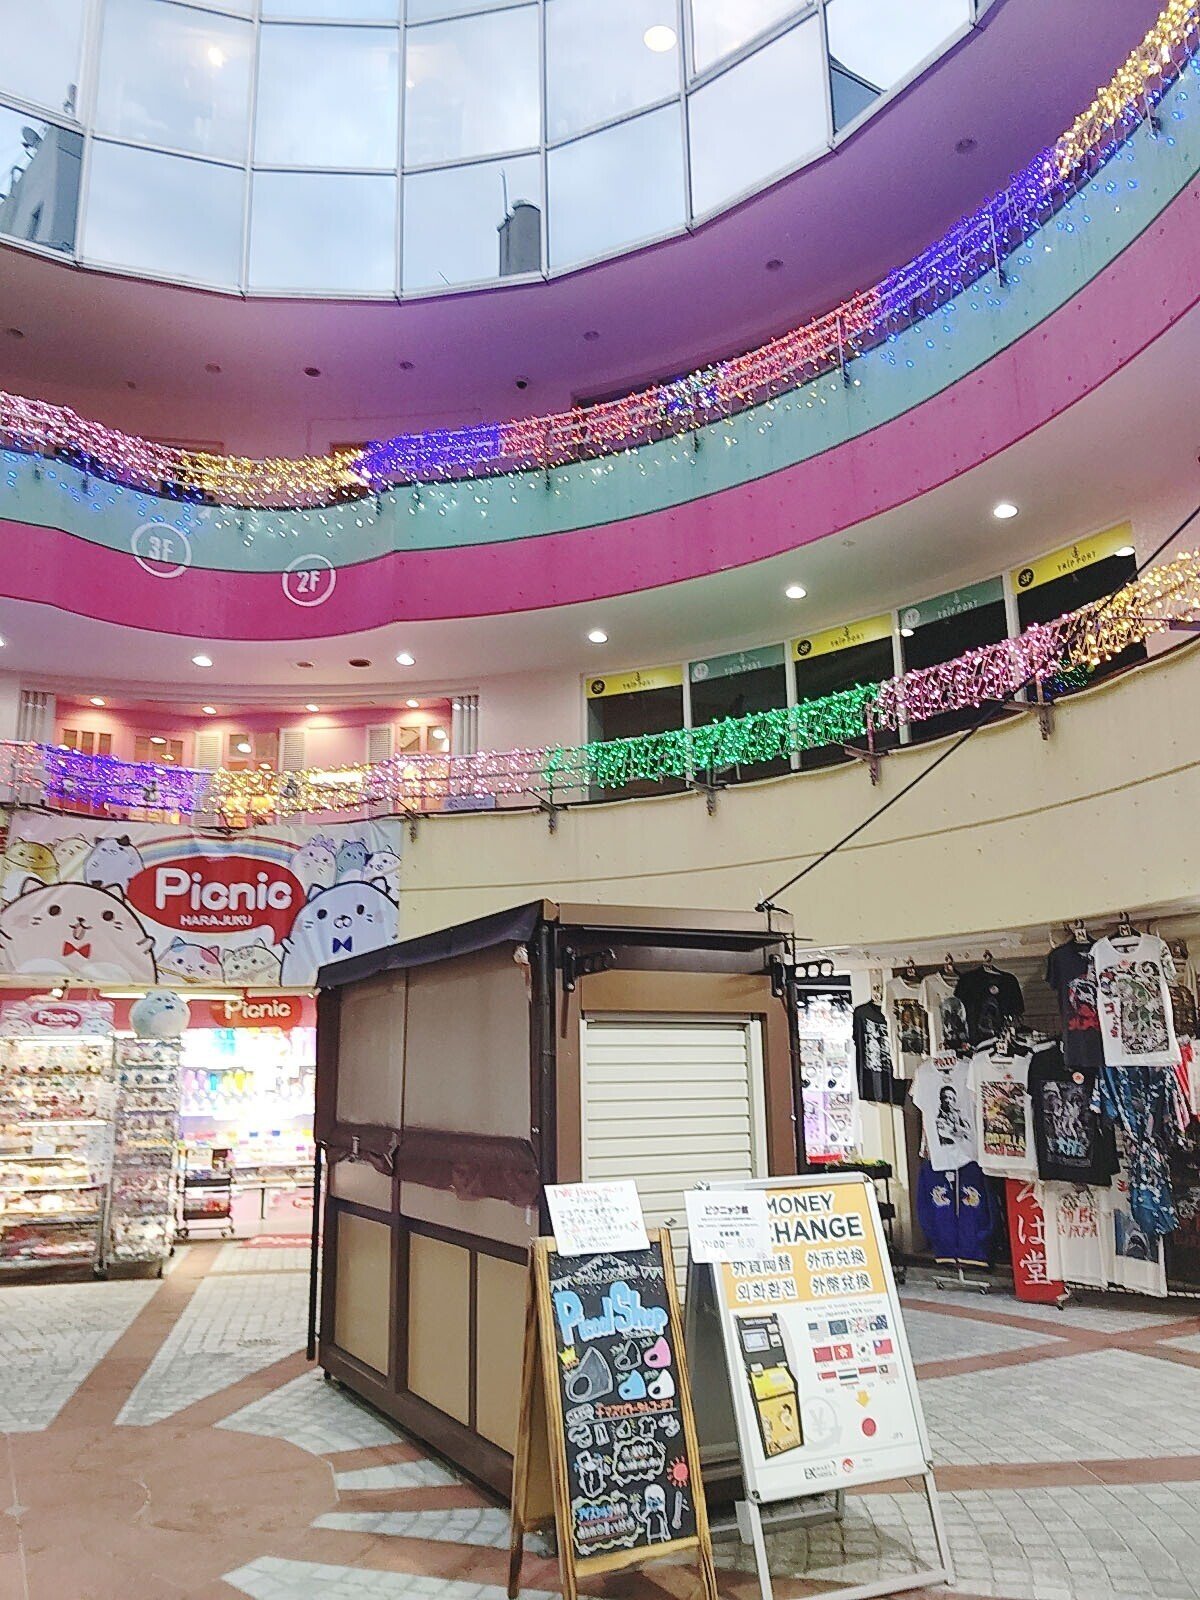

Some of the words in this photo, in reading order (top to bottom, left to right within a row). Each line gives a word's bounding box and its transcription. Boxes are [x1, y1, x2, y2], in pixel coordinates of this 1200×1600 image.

[149, 536, 174, 562] 3F
[296, 569, 320, 592] 2F
[155, 867, 292, 911] Picnic
[180, 914, 253, 926] HARAJUKU
[224, 999, 291, 1020] Picnic
[766, 1193, 833, 1216] MONEY
[770, 1215, 863, 1245] HANGE
